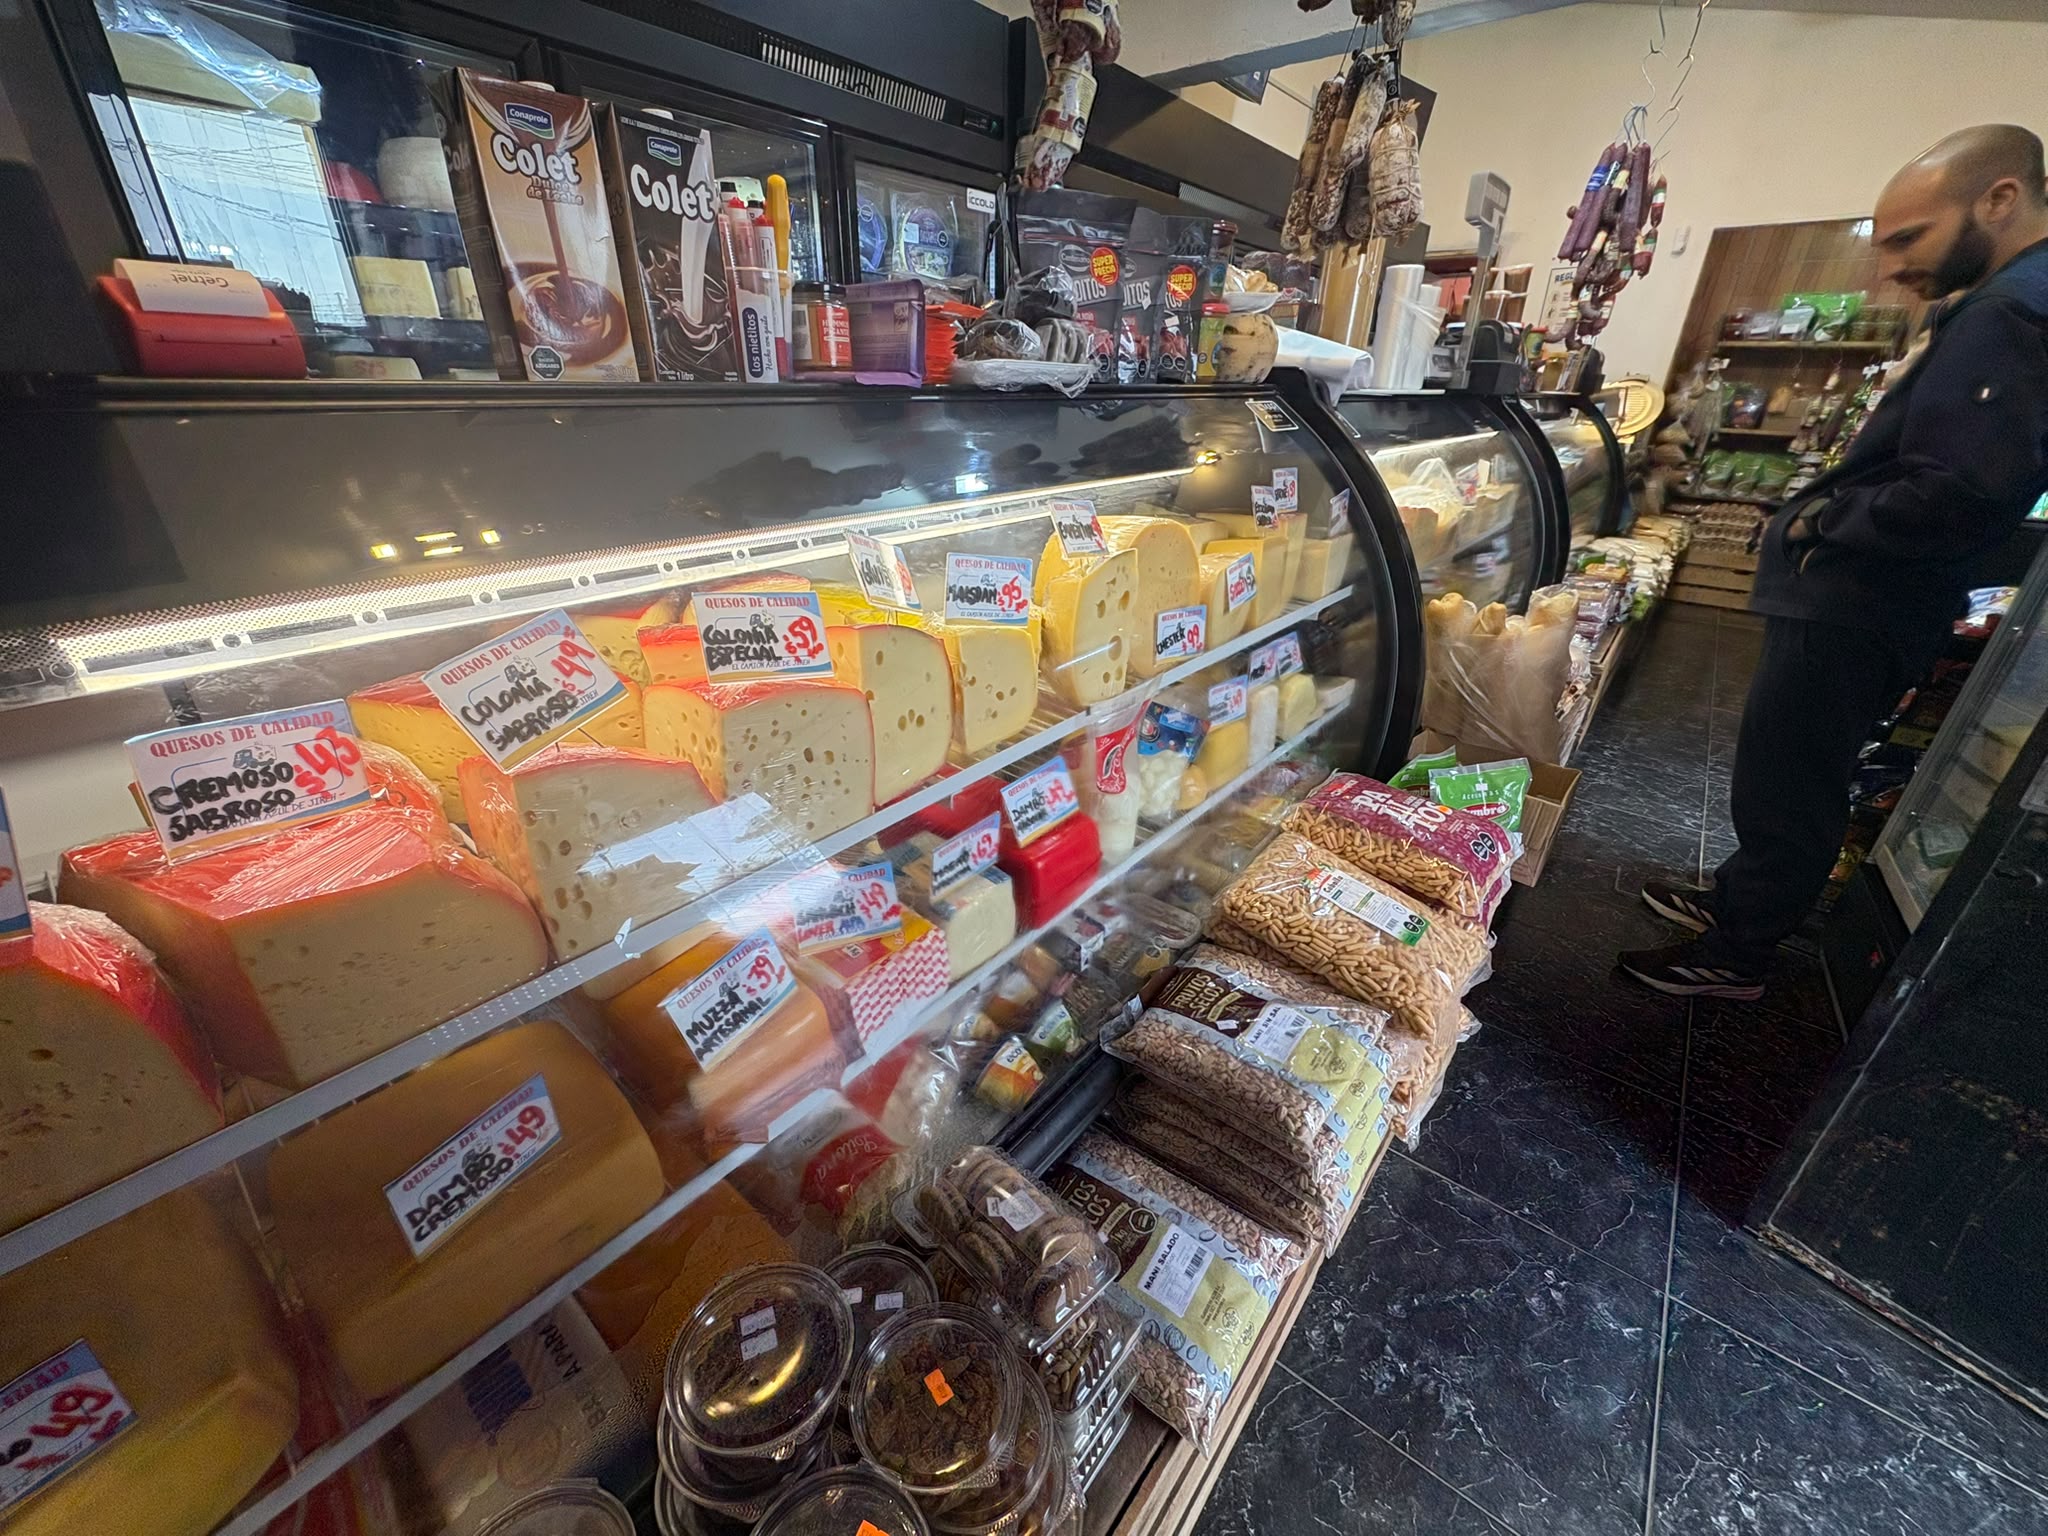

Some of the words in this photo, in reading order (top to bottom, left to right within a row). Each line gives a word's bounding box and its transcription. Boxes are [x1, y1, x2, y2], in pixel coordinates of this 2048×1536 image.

[509, 107, 548, 125] Conaprole
[491, 132, 581, 184] Colet
[650, 140, 678, 155] Conaprole
[630, 163, 716, 223] Colet
[1093, 255, 1114, 267] SUPER
[1094, 266, 1117, 277] PRECIO
[1170, 273, 1194, 284] SUPER
[171, 273, 229, 288] Getnet
[1170, 281, 1194, 292] PRECIO
[746, 312, 760, 354] nietitos
[985, 560, 995, 570] DE
[705, 597, 747, 609] QUESOS
[750, 597, 764, 608] DE
[767, 596, 810, 607] CALIDAD
[441, 653, 493, 687] QUESOS
[493, 643, 512, 662] DE
[511, 618, 562, 650] CALIDAD
[703, 623, 780, 646] COLONIA
[705, 645, 783, 672] ESPECIAL
[460, 676, 553, 727] COLONIA
[150, 730, 226, 759] QUESOS
[231, 726, 257, 746] DE
[260, 710, 335, 737] CALIDAD
[486, 689, 580, 752] SABROSO
[148, 760, 296, 815] CREMOSO
[167, 788, 297, 841] SABROSO
[291, 800, 306, 813] DE
[1011, 795, 1047, 822] DAMBO
[848, 868, 886, 881] CALIDAD
[676, 976, 713, 1010] QUESOS
[712, 965, 728, 981] DE
[1172, 972, 1211, 1009] FRUTOS
[1188, 985, 1226, 1020] SECOS
[402, 1147, 457, 1192] QUESOS
[458, 1130, 479, 1149] DE
[480, 1086, 534, 1132] CALIDAD
[405, 1152, 497, 1230] DAMBO
[414, 1157, 514, 1242] CREMOSO
[1144, 1265, 1161, 1291] MANI
[1159, 1232, 1181, 1267] SALADO
